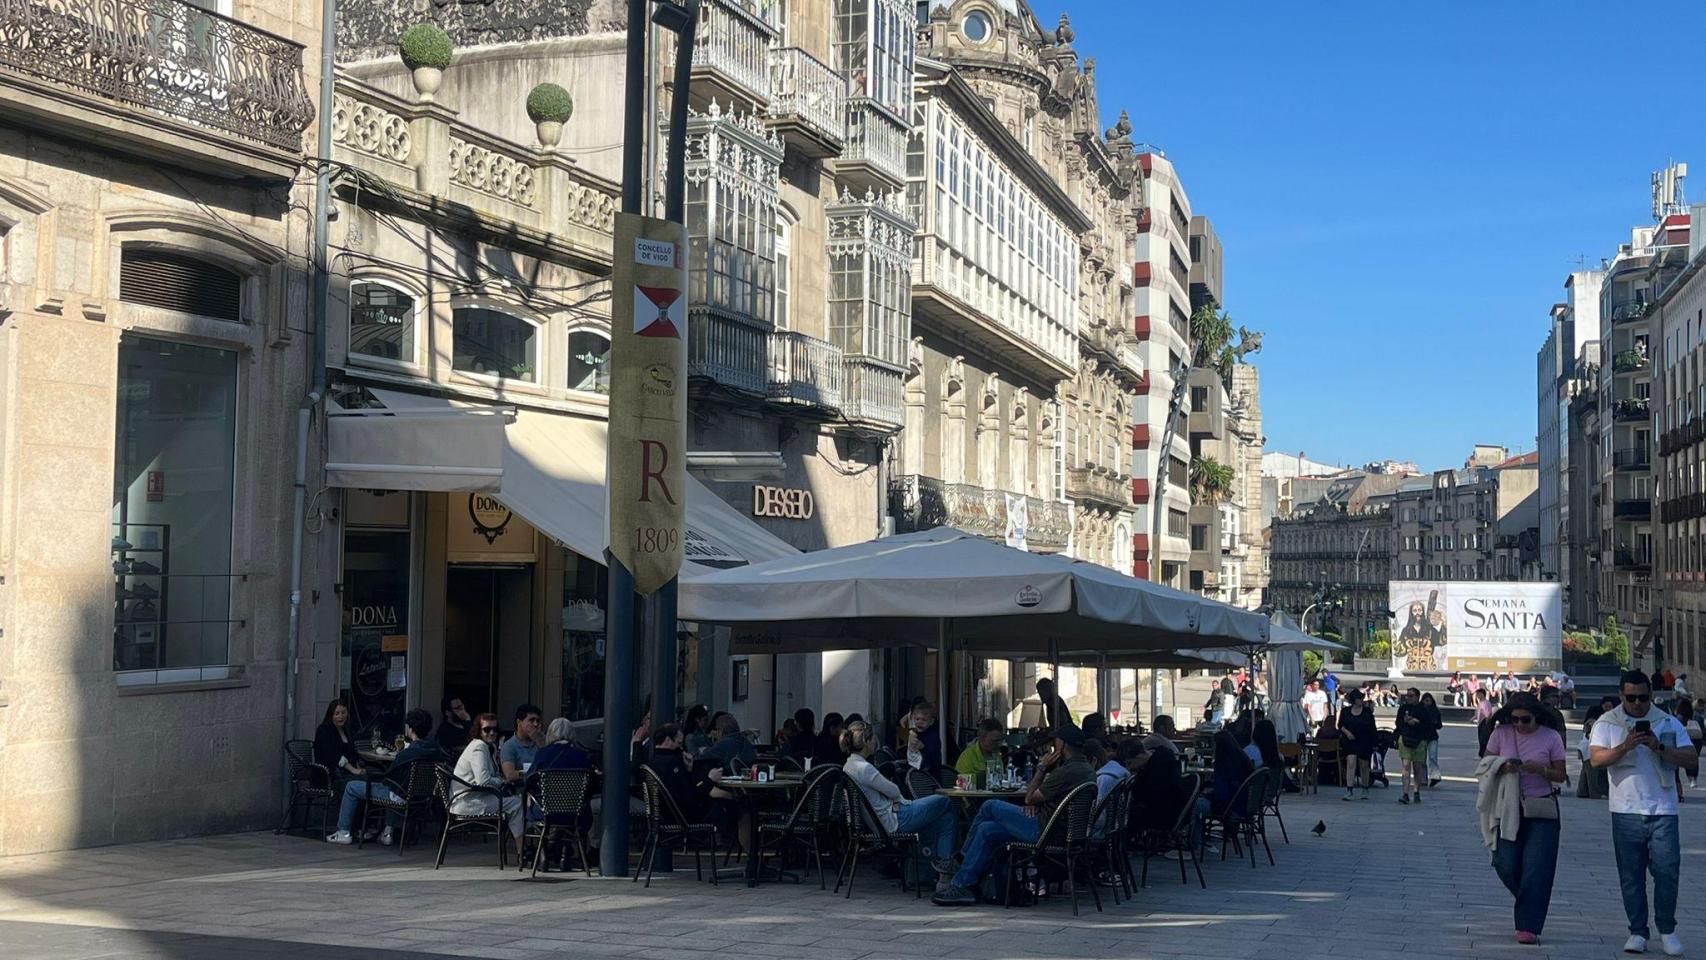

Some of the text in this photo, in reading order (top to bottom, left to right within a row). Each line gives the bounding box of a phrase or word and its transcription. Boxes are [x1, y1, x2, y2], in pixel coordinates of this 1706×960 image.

[638, 243, 671, 254] CONCELLO
[653, 253, 668, 261] VIGO
[638, 440, 676, 505] R
[635, 527, 678, 553] 1809
[352, 606, 397, 625] DONA
[1464, 598, 1547, 630] SANTA
